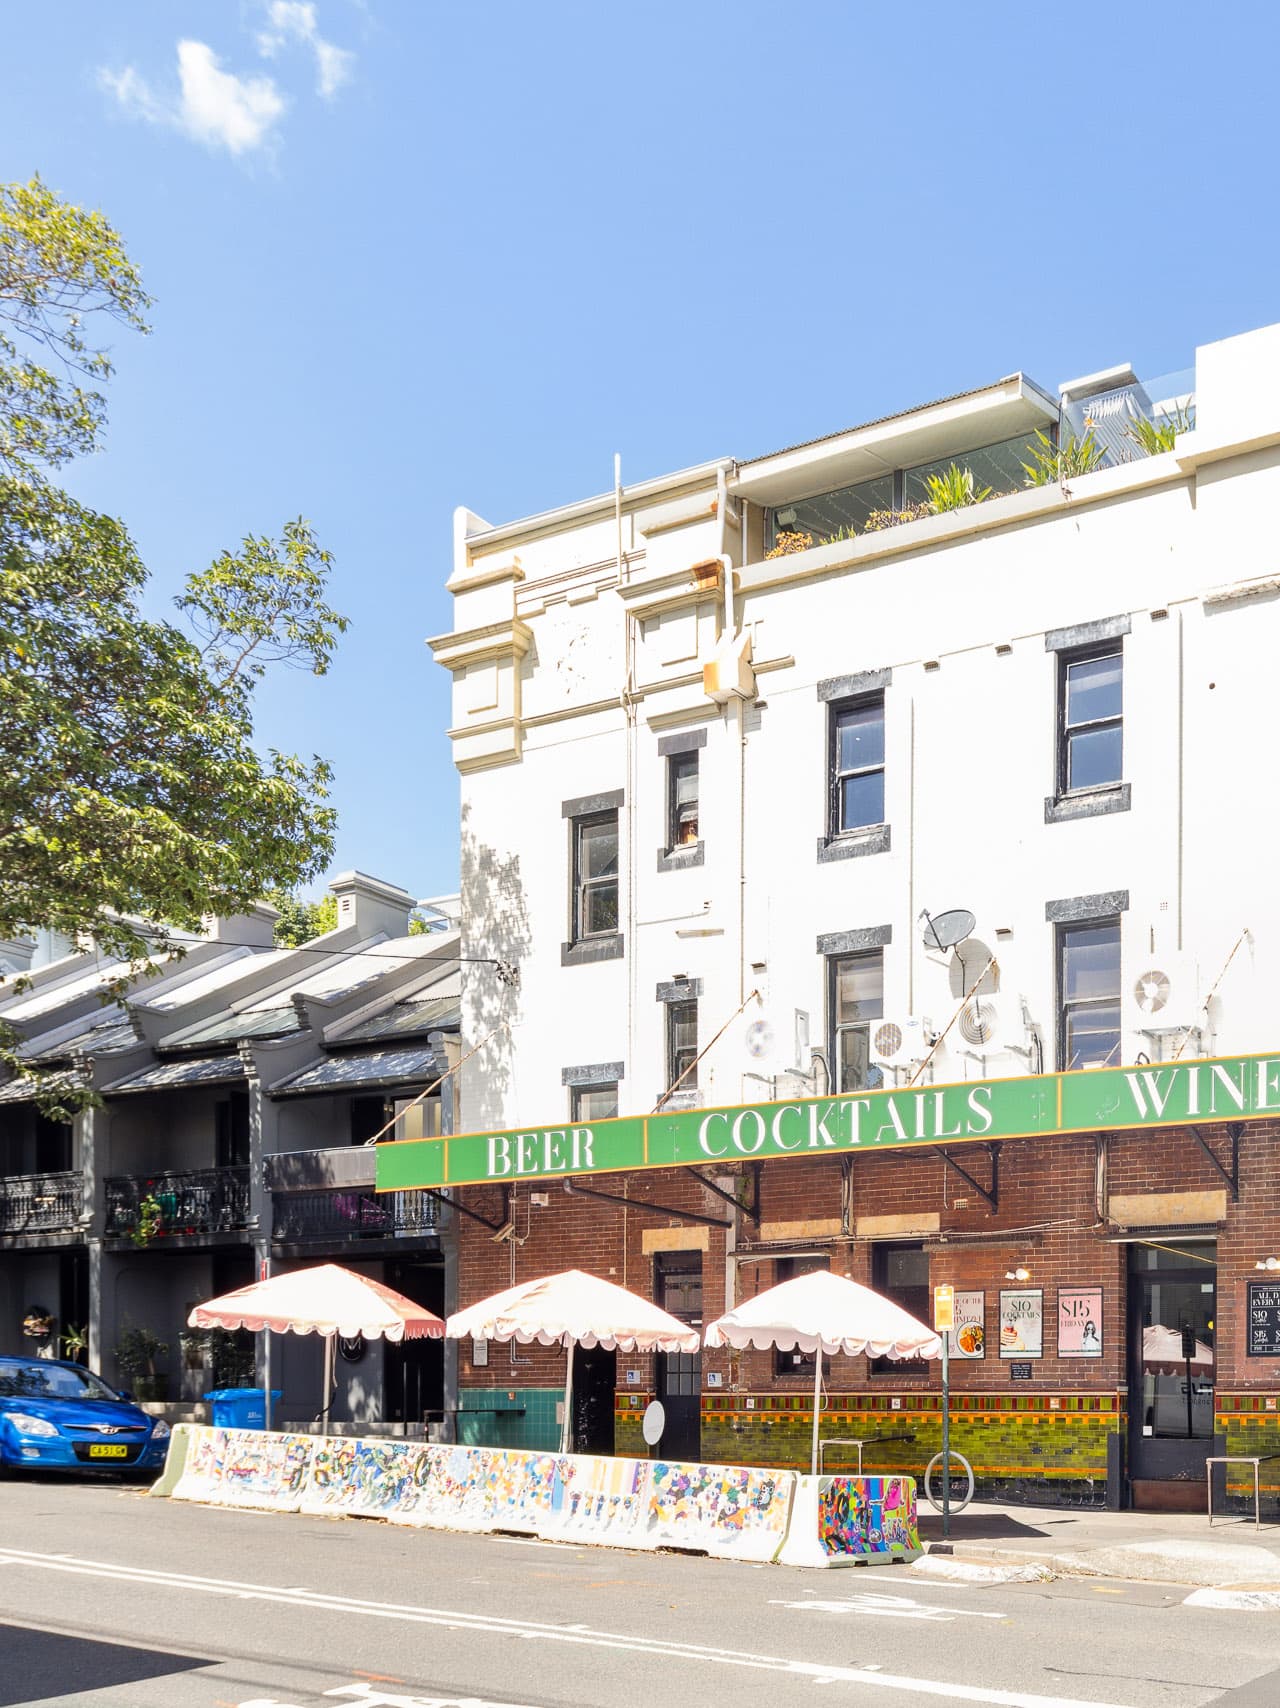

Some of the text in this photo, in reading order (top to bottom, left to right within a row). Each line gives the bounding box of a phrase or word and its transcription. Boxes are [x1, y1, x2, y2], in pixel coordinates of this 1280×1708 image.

[698, 1086, 994, 1157] COCKTAILS
[486, 1127, 596, 1177] BEER
[1252, 1298, 1274, 1306] EVERY
[1258, 1291, 1272, 1299] ALL
[1061, 1299, 1091, 1318] $15
